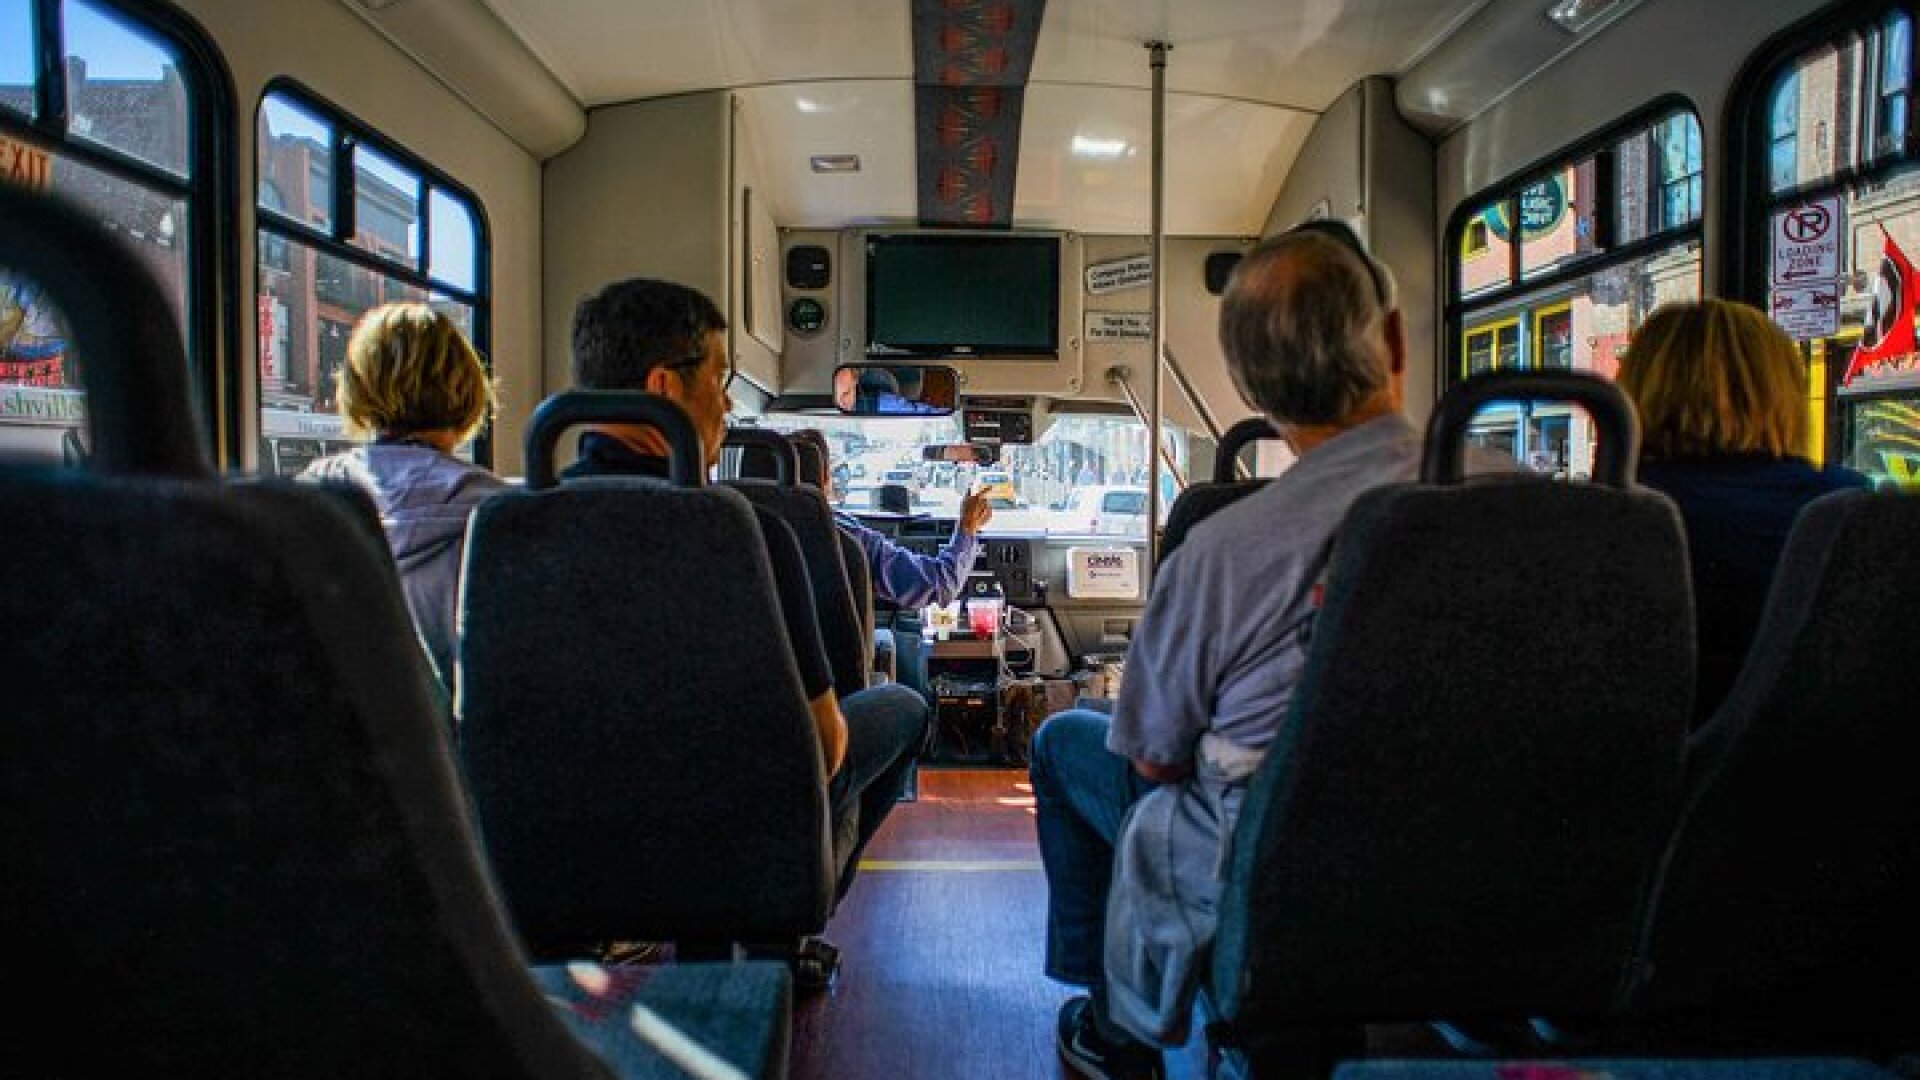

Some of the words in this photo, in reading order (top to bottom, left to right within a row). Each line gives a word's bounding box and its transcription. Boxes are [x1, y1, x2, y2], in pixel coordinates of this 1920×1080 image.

[1779, 241, 1834, 259] LOADING
[1789, 256, 1821, 270] ZONE
[1102, 316, 1123, 326] Thank
[1125, 318, 1140, 327] You
[1090, 327, 1102, 336] For
[0, 391, 82, 416] shville
